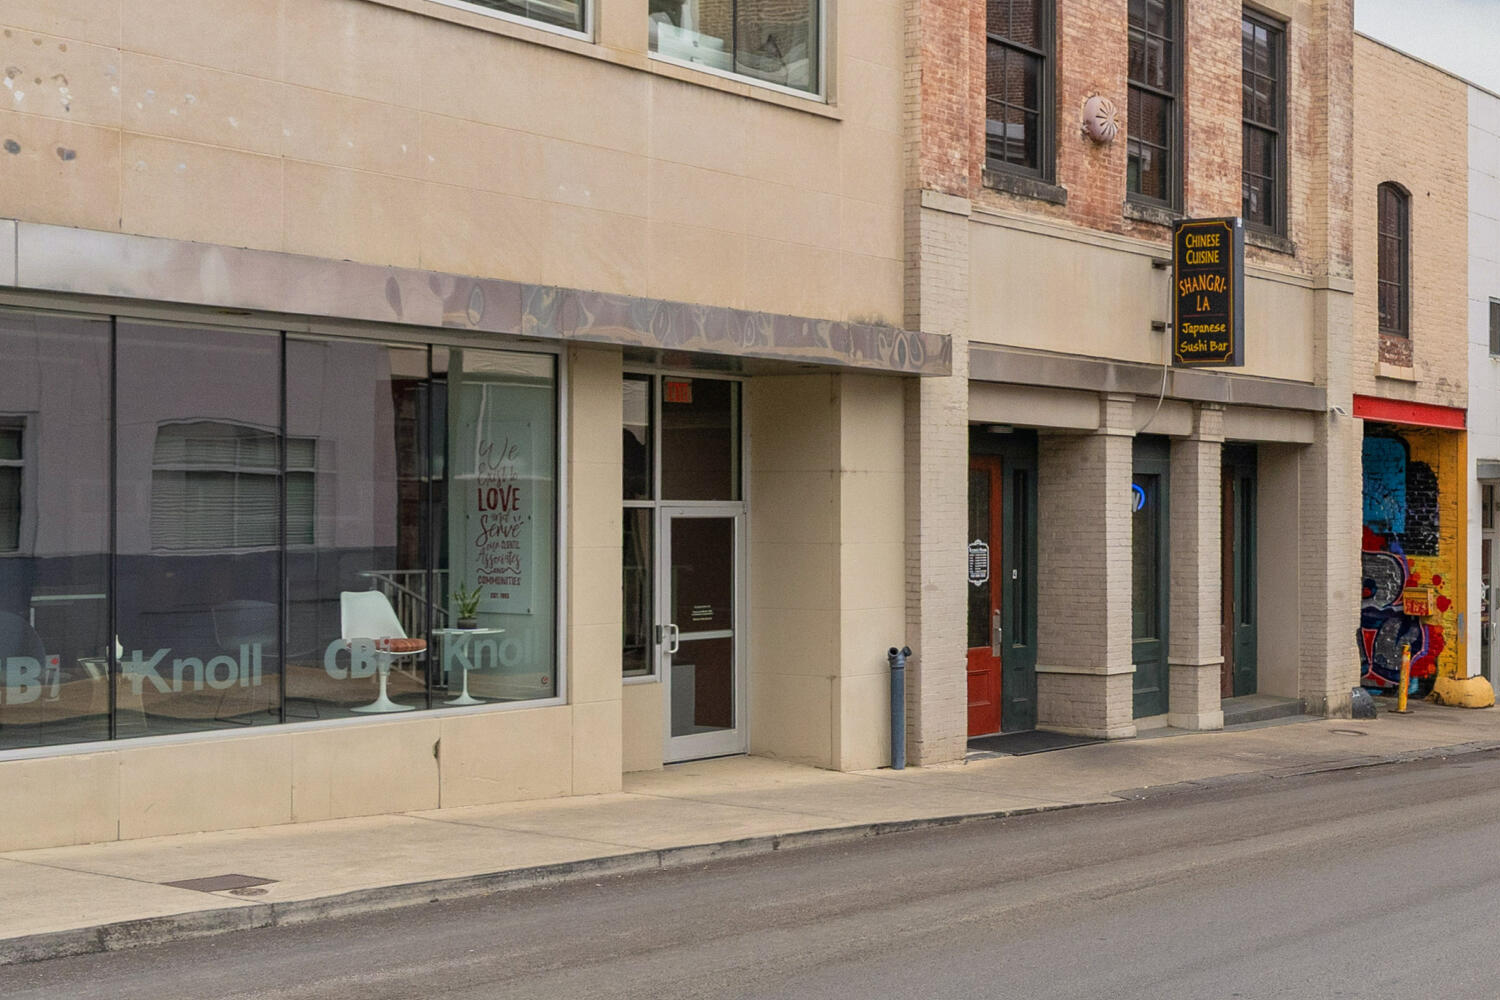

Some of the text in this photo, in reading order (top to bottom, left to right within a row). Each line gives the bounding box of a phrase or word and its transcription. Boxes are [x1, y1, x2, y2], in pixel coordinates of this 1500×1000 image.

[1185, 233, 1220, 248] CHINESE
[1186, 249, 1220, 264] CUISINE
[1196, 295, 1211, 312] LA
[1182, 322, 1226, 337] Japanese
[1180, 339, 1228, 353] Sushi Bar
[477, 485, 520, 512] LOVE
[444, 629, 540, 672] Knoll
[0, 643, 262, 705] Bi Knoll
